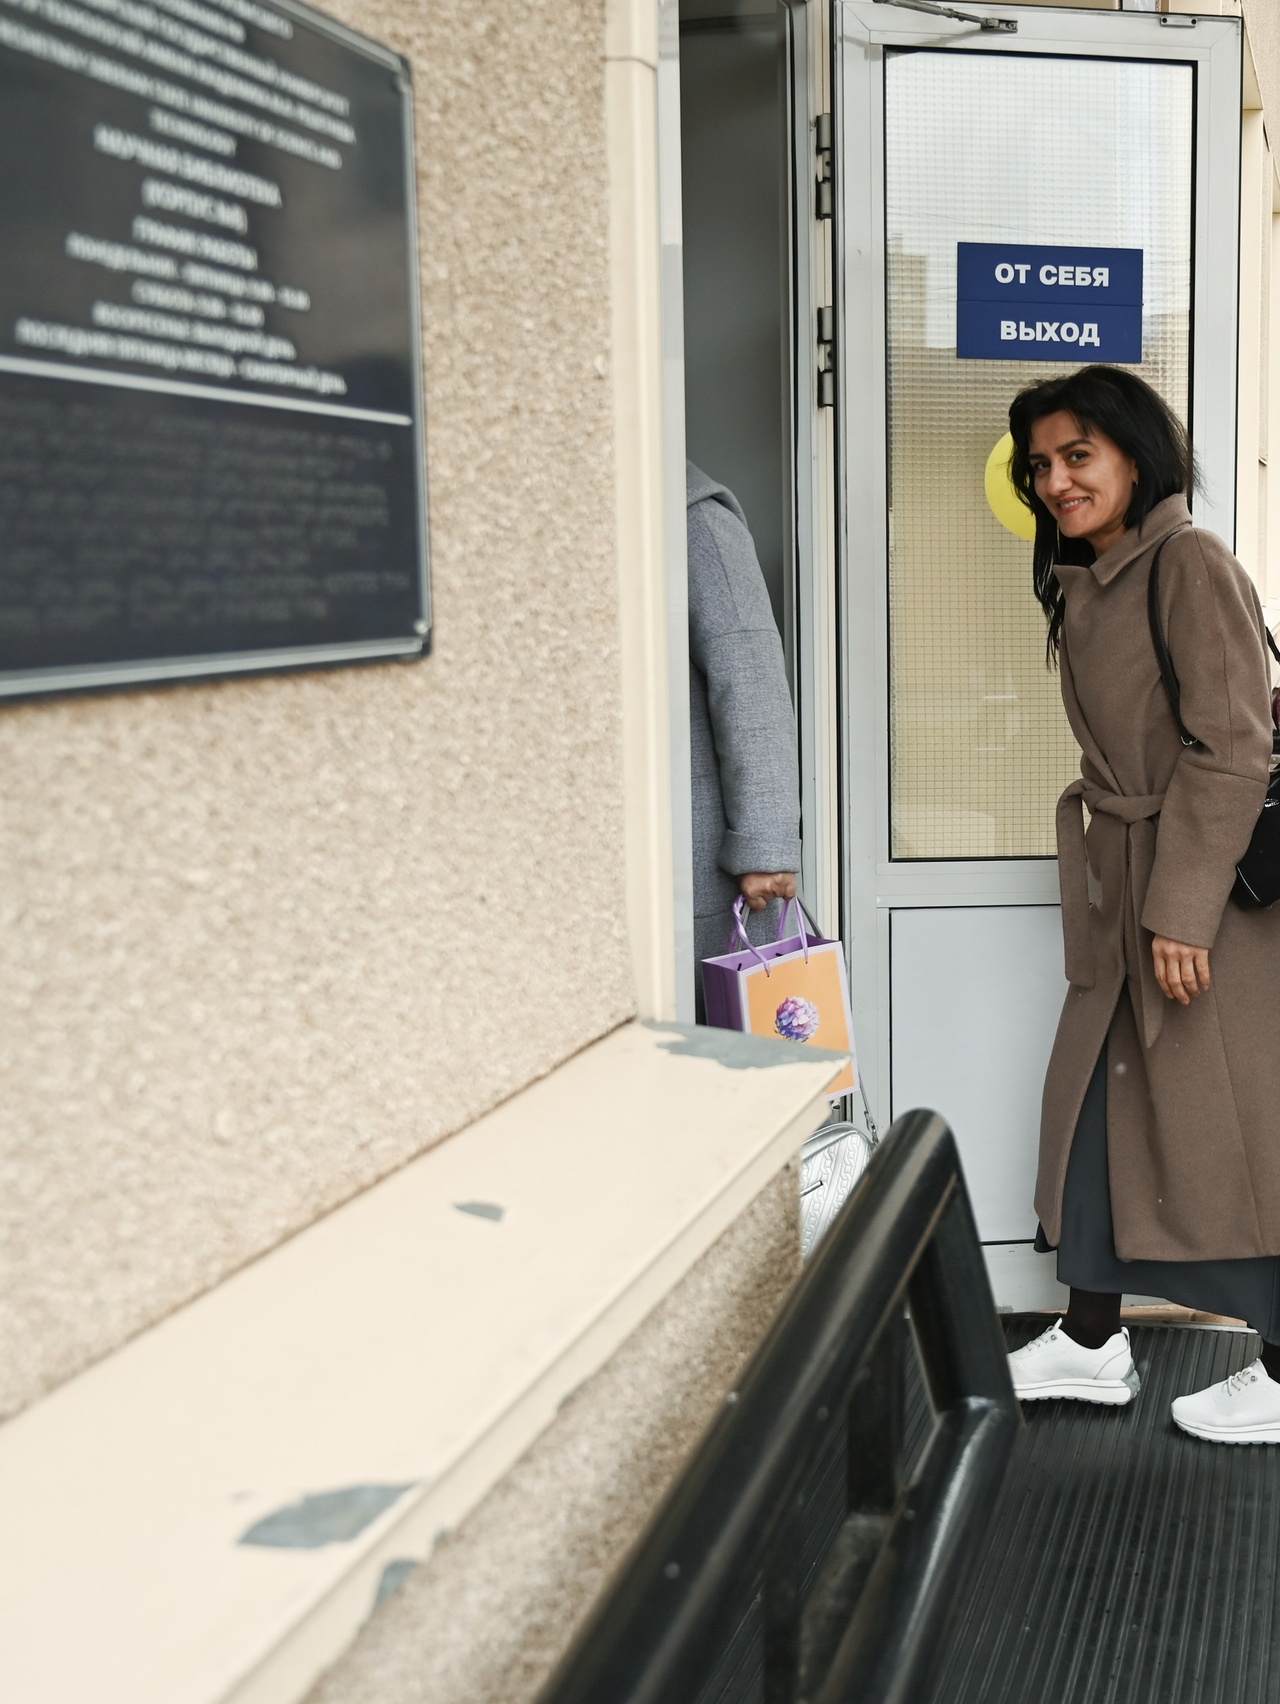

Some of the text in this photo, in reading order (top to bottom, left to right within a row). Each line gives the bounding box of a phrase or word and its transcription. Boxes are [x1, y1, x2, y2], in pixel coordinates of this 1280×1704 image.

[994, 263, 1110, 287] ОТ СЕБЯ
[1000, 320, 1100, 347] ВЫХОД
